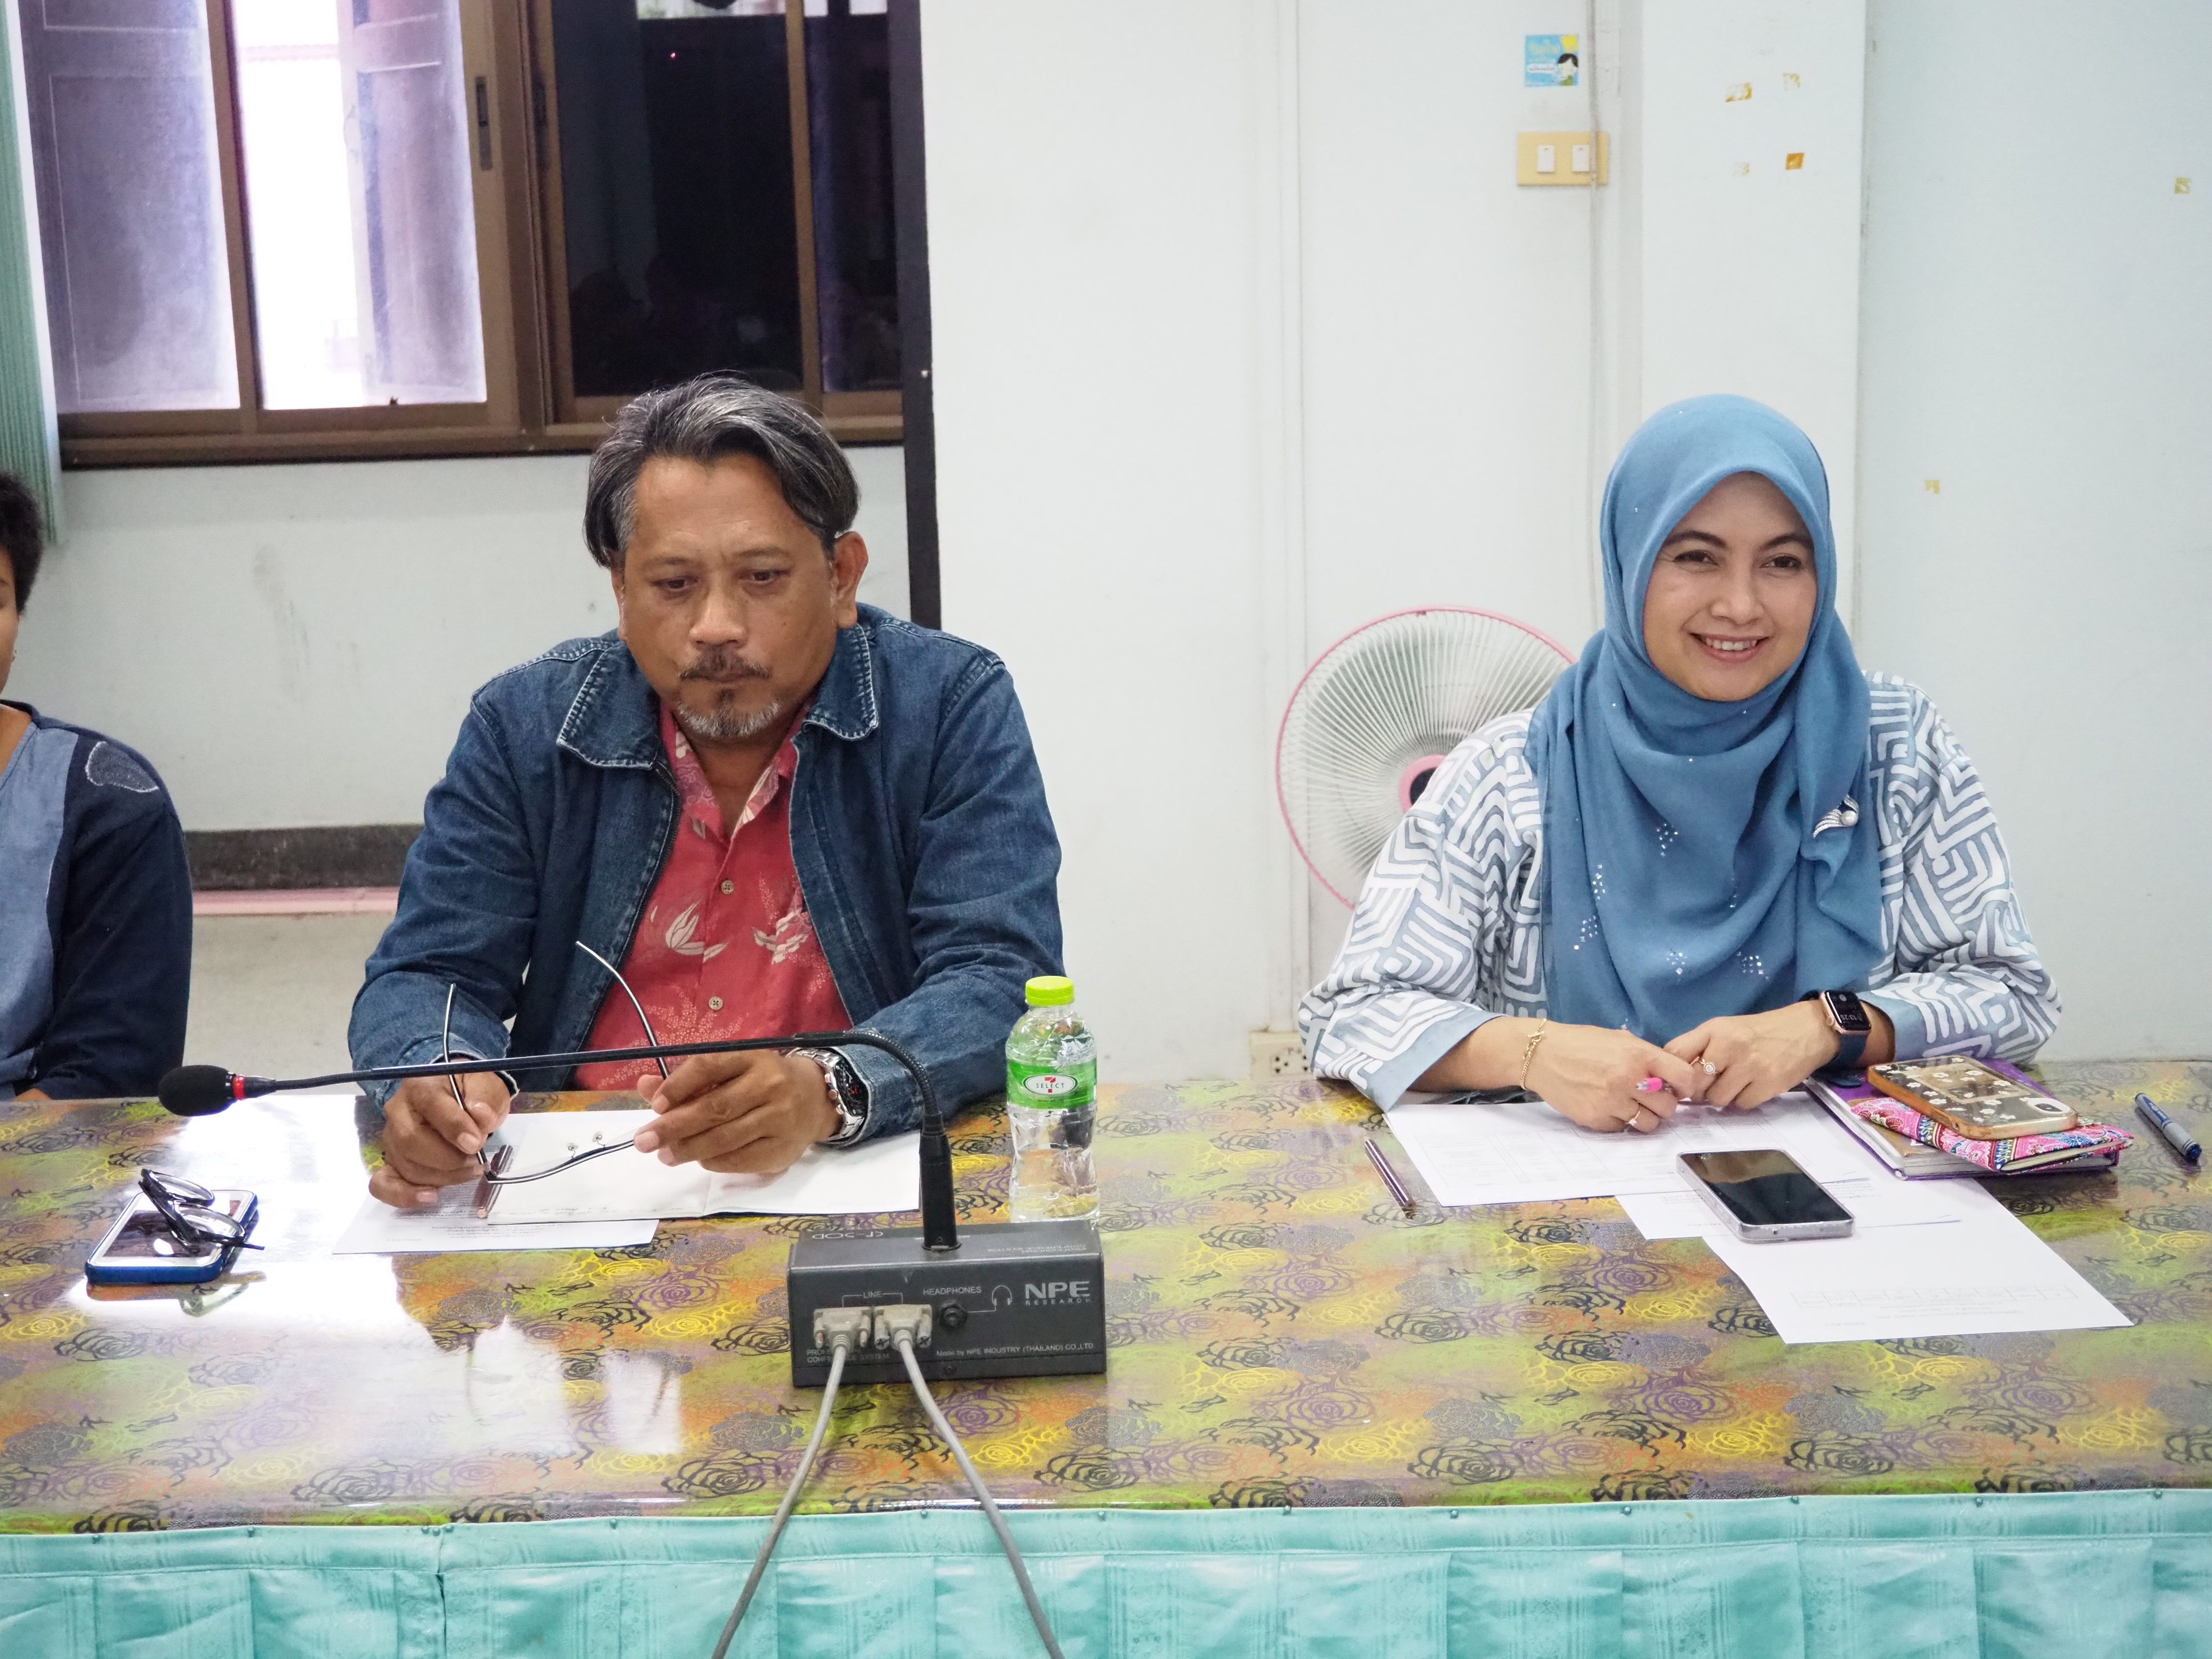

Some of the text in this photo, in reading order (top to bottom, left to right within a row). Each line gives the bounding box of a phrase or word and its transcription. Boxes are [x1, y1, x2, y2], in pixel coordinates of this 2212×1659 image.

[923, 1286, 982, 1296] HEADPHONES
[1025, 1281, 1090, 1299] NPE
[1022, 1344, 1064, 1352] (THAILAND)
